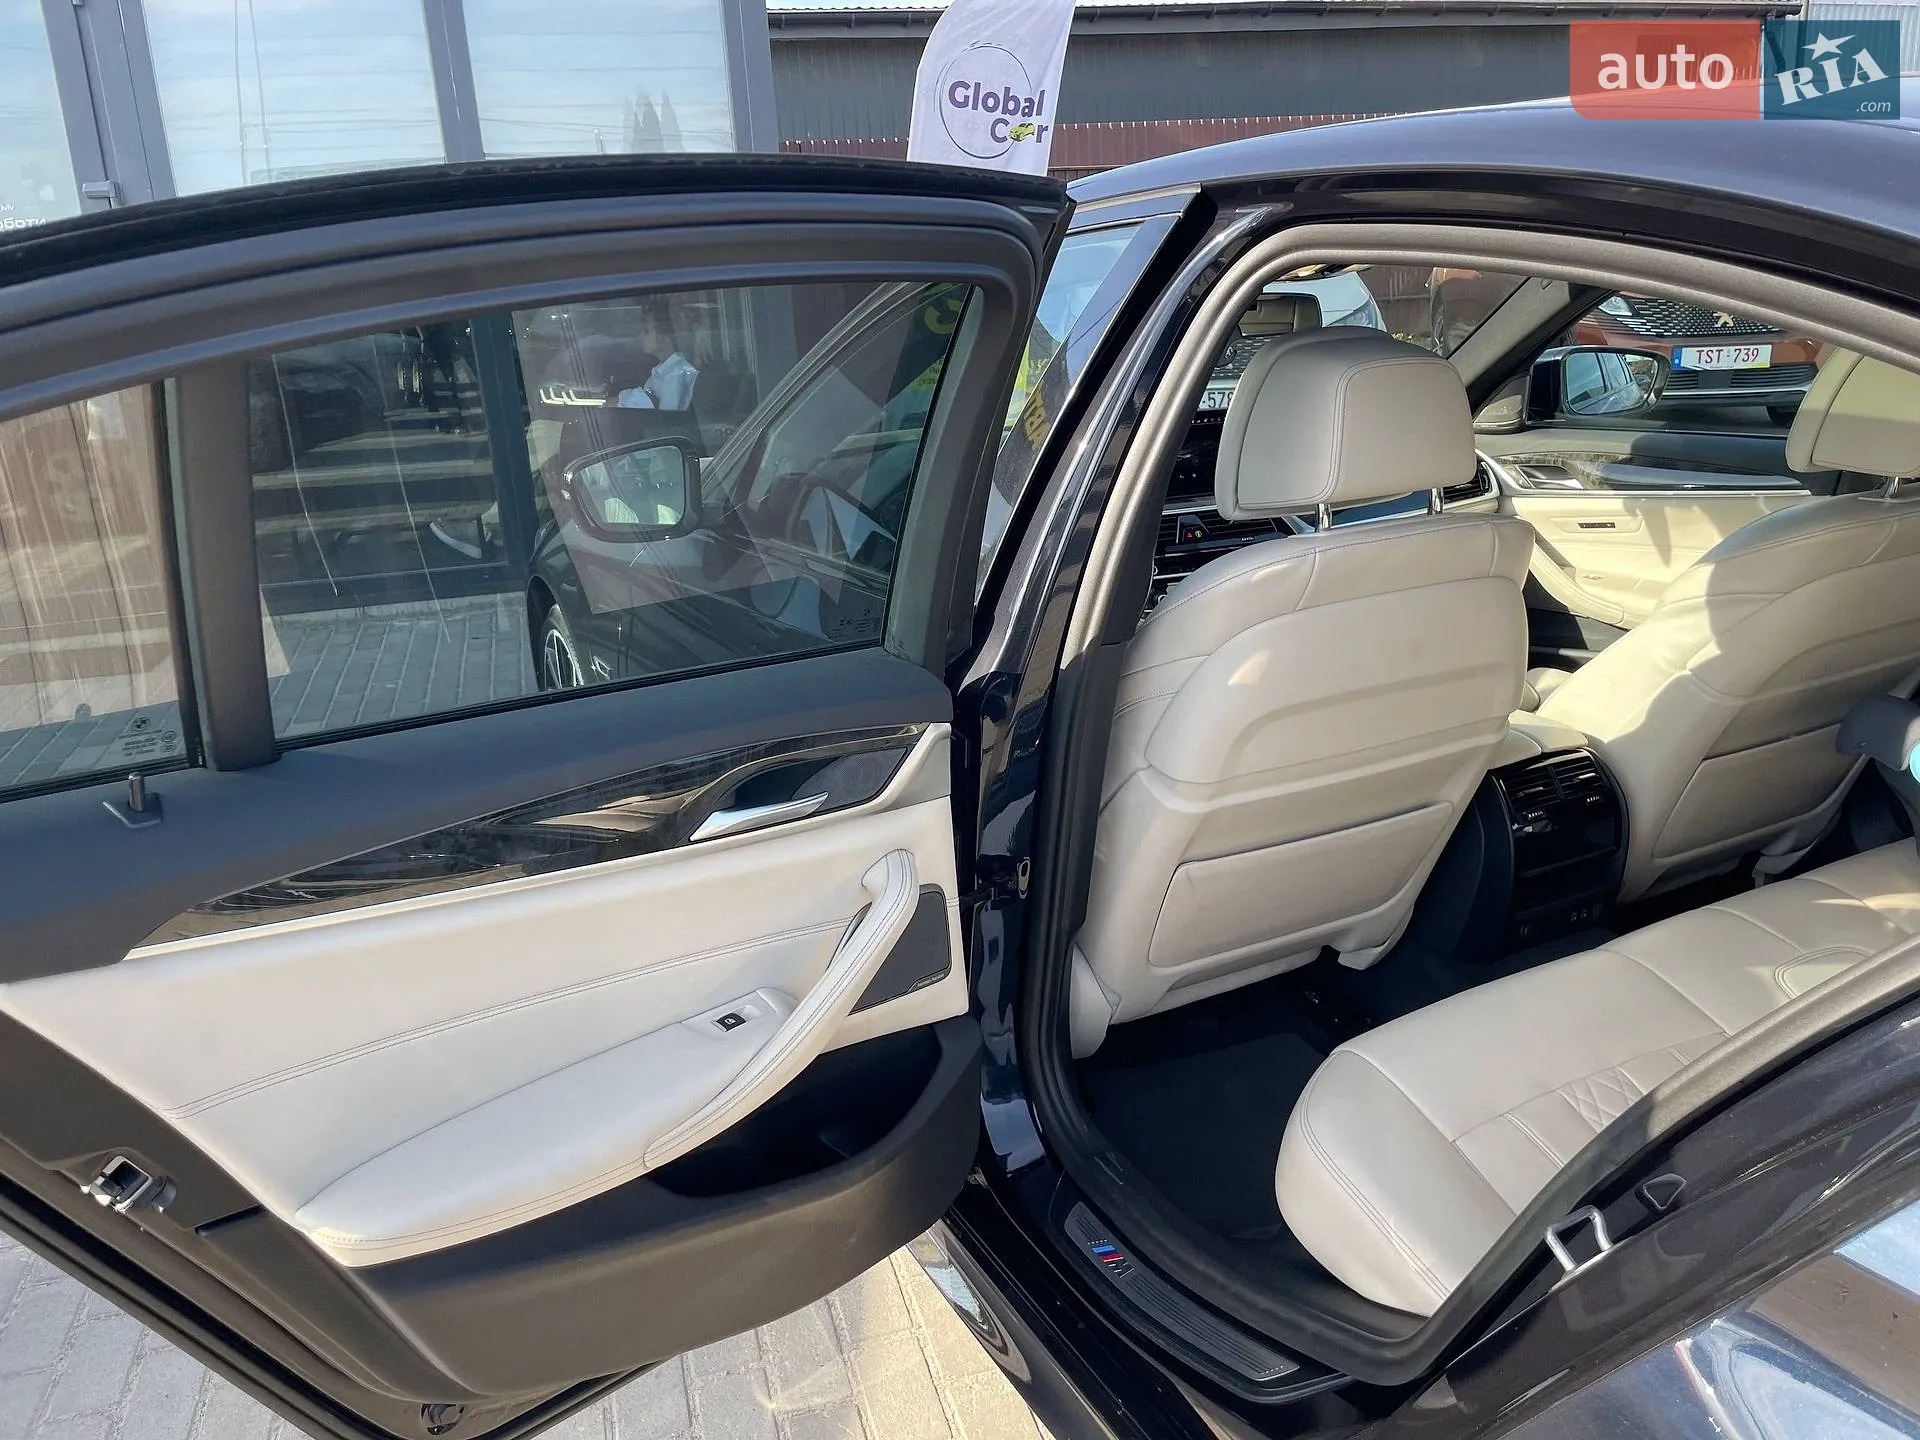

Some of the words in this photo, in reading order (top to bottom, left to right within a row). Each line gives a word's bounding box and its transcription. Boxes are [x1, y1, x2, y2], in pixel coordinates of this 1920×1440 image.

[948, 80, 1046, 118] Global
[990, 117, 1049, 143] Cr
[1696, 349, 1724, 364] TST
[1734, 348, 1760, 363] 739
